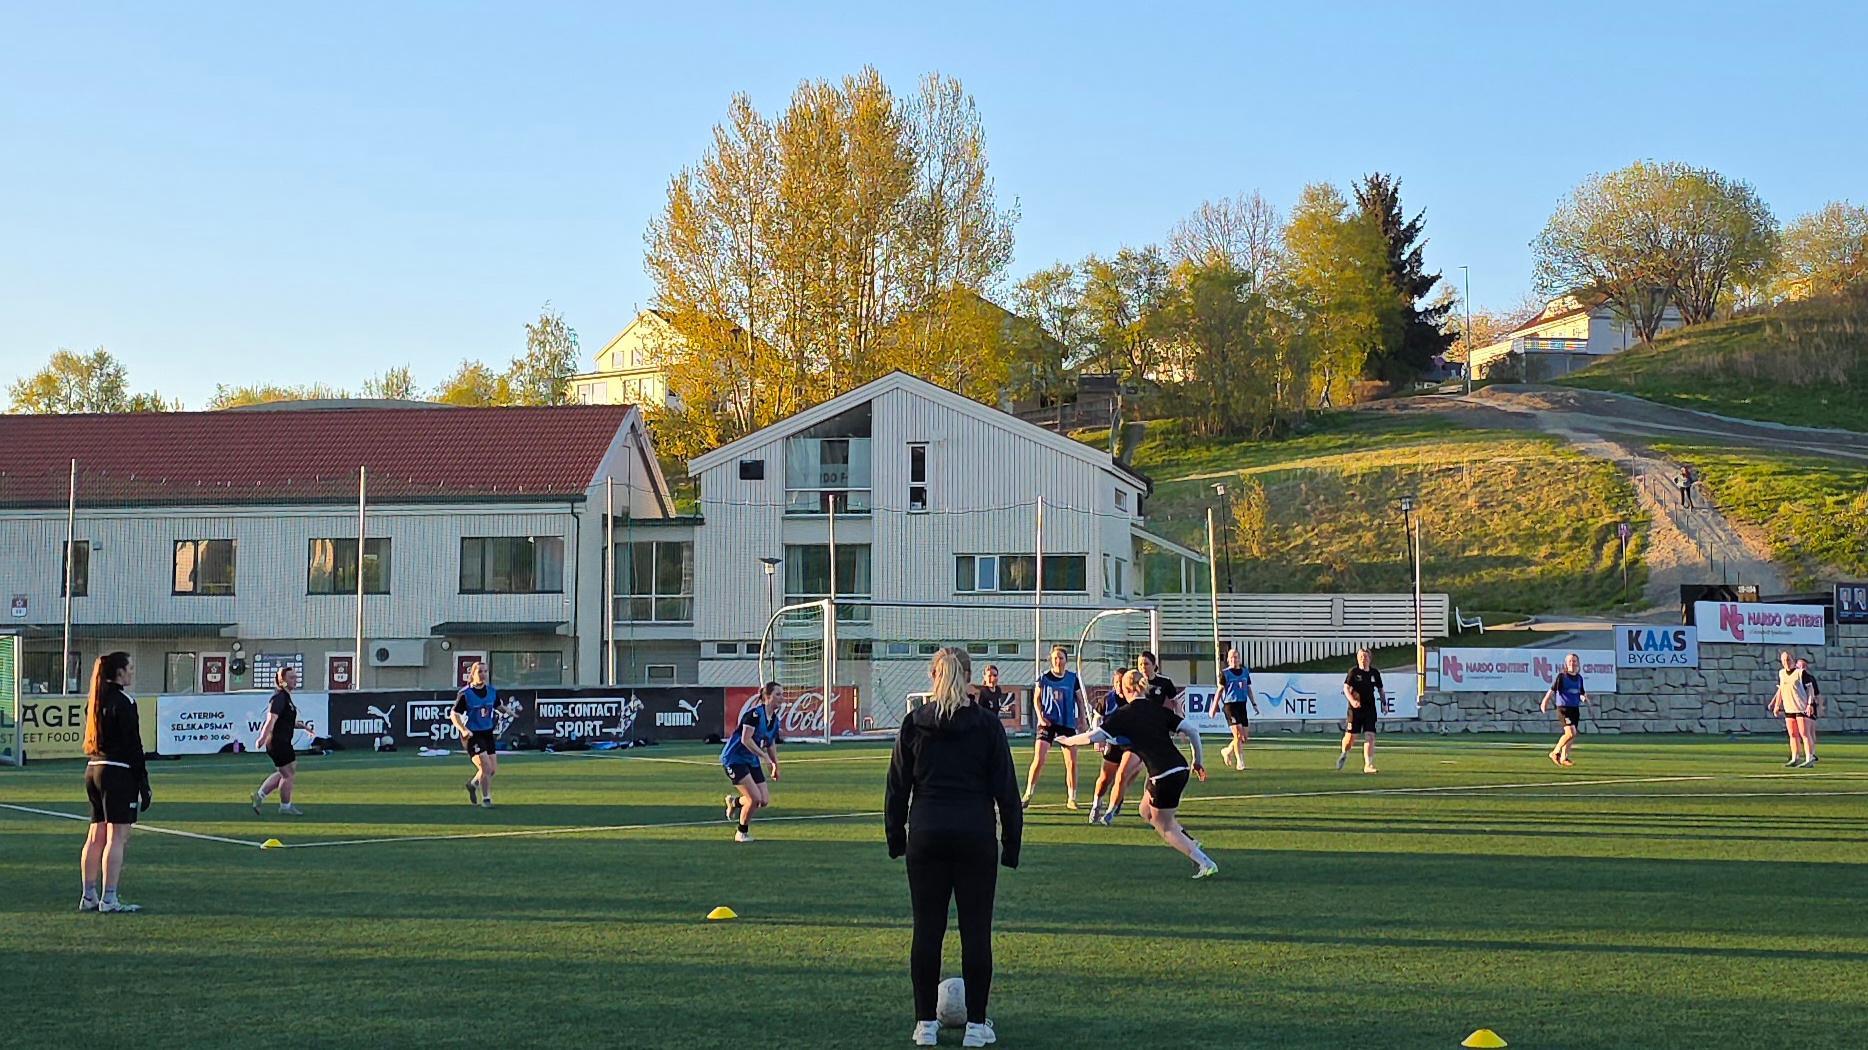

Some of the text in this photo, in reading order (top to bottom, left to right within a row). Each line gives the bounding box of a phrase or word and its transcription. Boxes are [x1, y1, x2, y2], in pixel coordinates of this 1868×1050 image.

[1628, 630, 1687, 651] KAAS
[1628, 653, 1688, 664] BYGG AS
[539, 703, 618, 718] NOR-CONTACT
[1285, 699, 1317, 714] NTE
[1376, 698, 1396, 713] TE
[180, 712, 225, 720] CATERING
[655, 712, 692, 727] PUMA
[171, 722, 234, 731] SELSKAPSMAT
[341, 719, 384, 734] PUMA
[430, 723, 460, 741] SPO
[555, 720, 603, 738] SPORT
[0, 732, 80, 744] STEET FOOD
